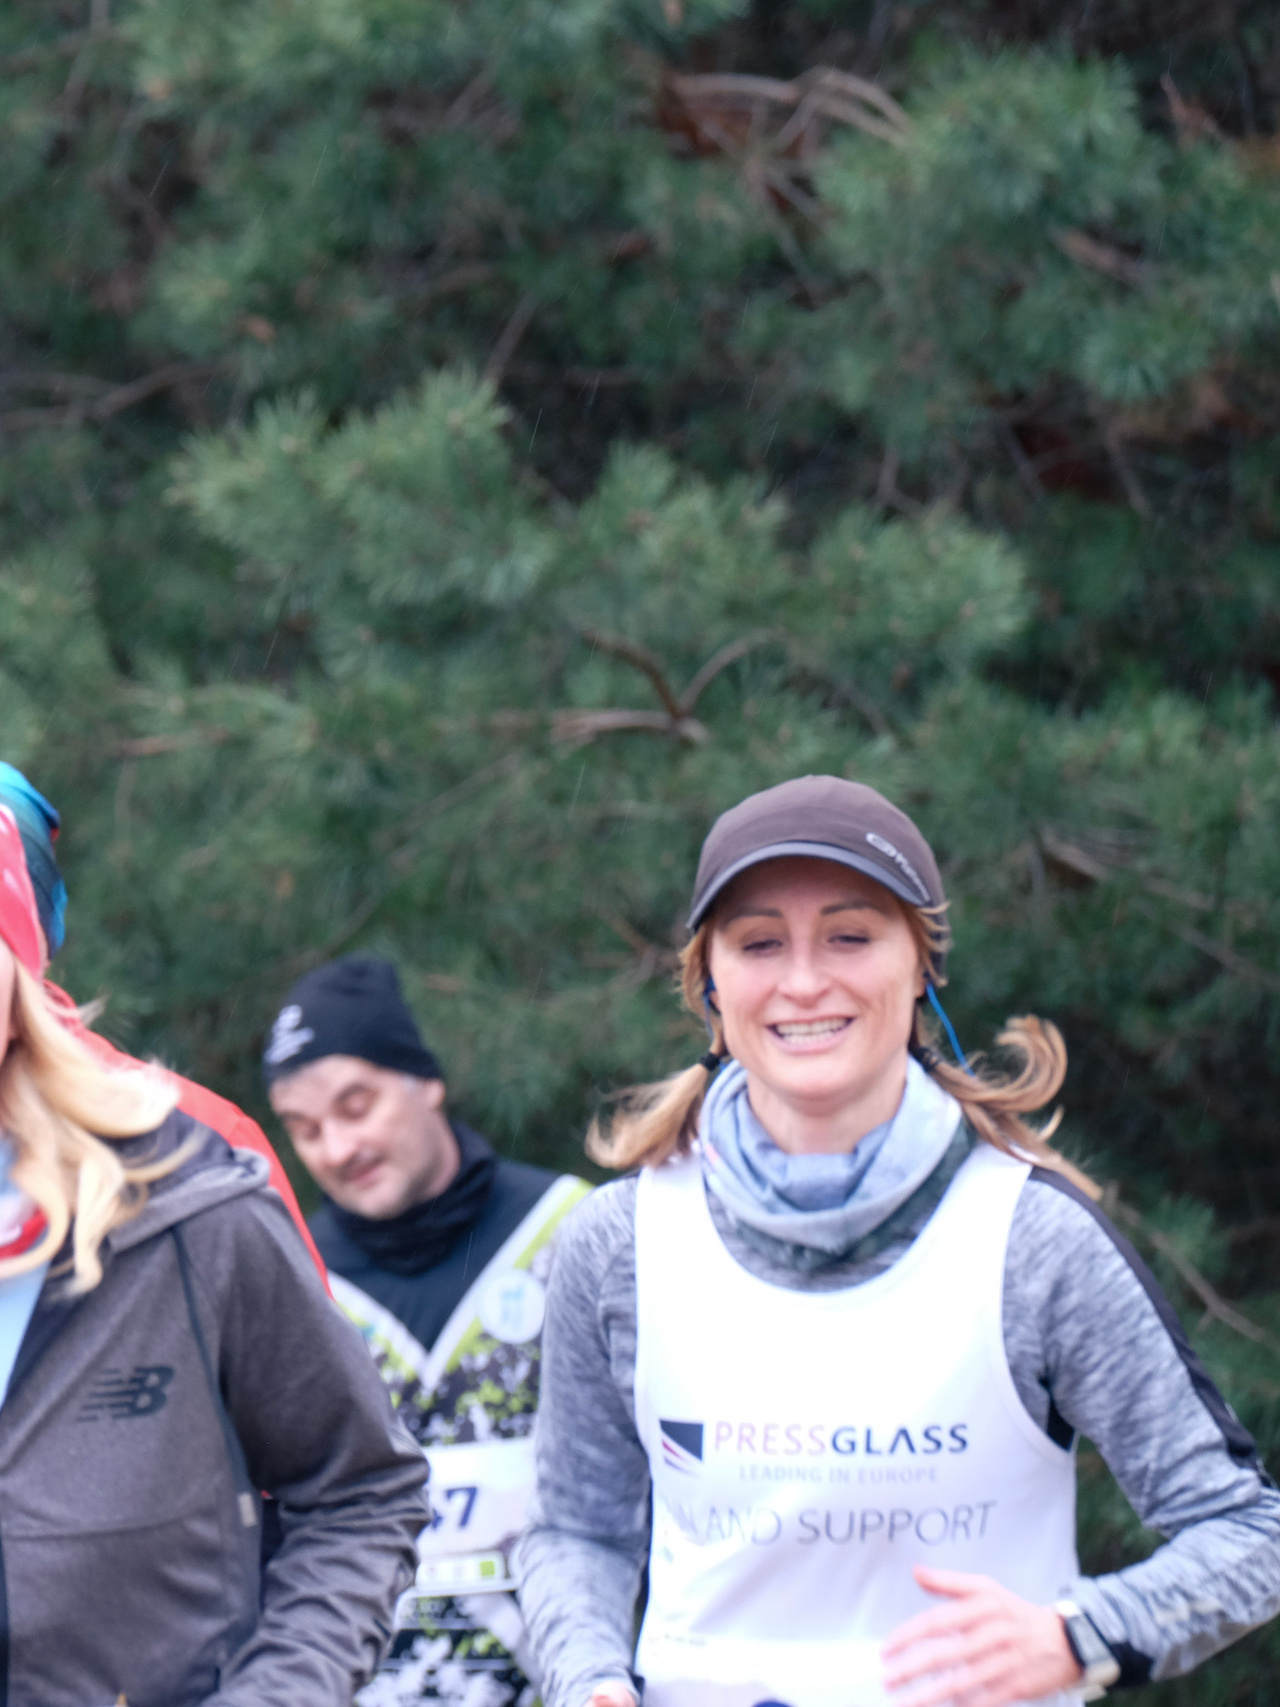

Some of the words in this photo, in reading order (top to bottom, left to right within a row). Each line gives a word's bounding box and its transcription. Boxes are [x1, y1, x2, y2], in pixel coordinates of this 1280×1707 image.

[713, 1420, 970, 1458] PRESSGLASS
[738, 1463, 823, 1484] LEADING
[828, 1465, 851, 1484] IN
[857, 1466, 937, 1485] EUROPE
[796, 1499, 999, 1546] SUPPORT
